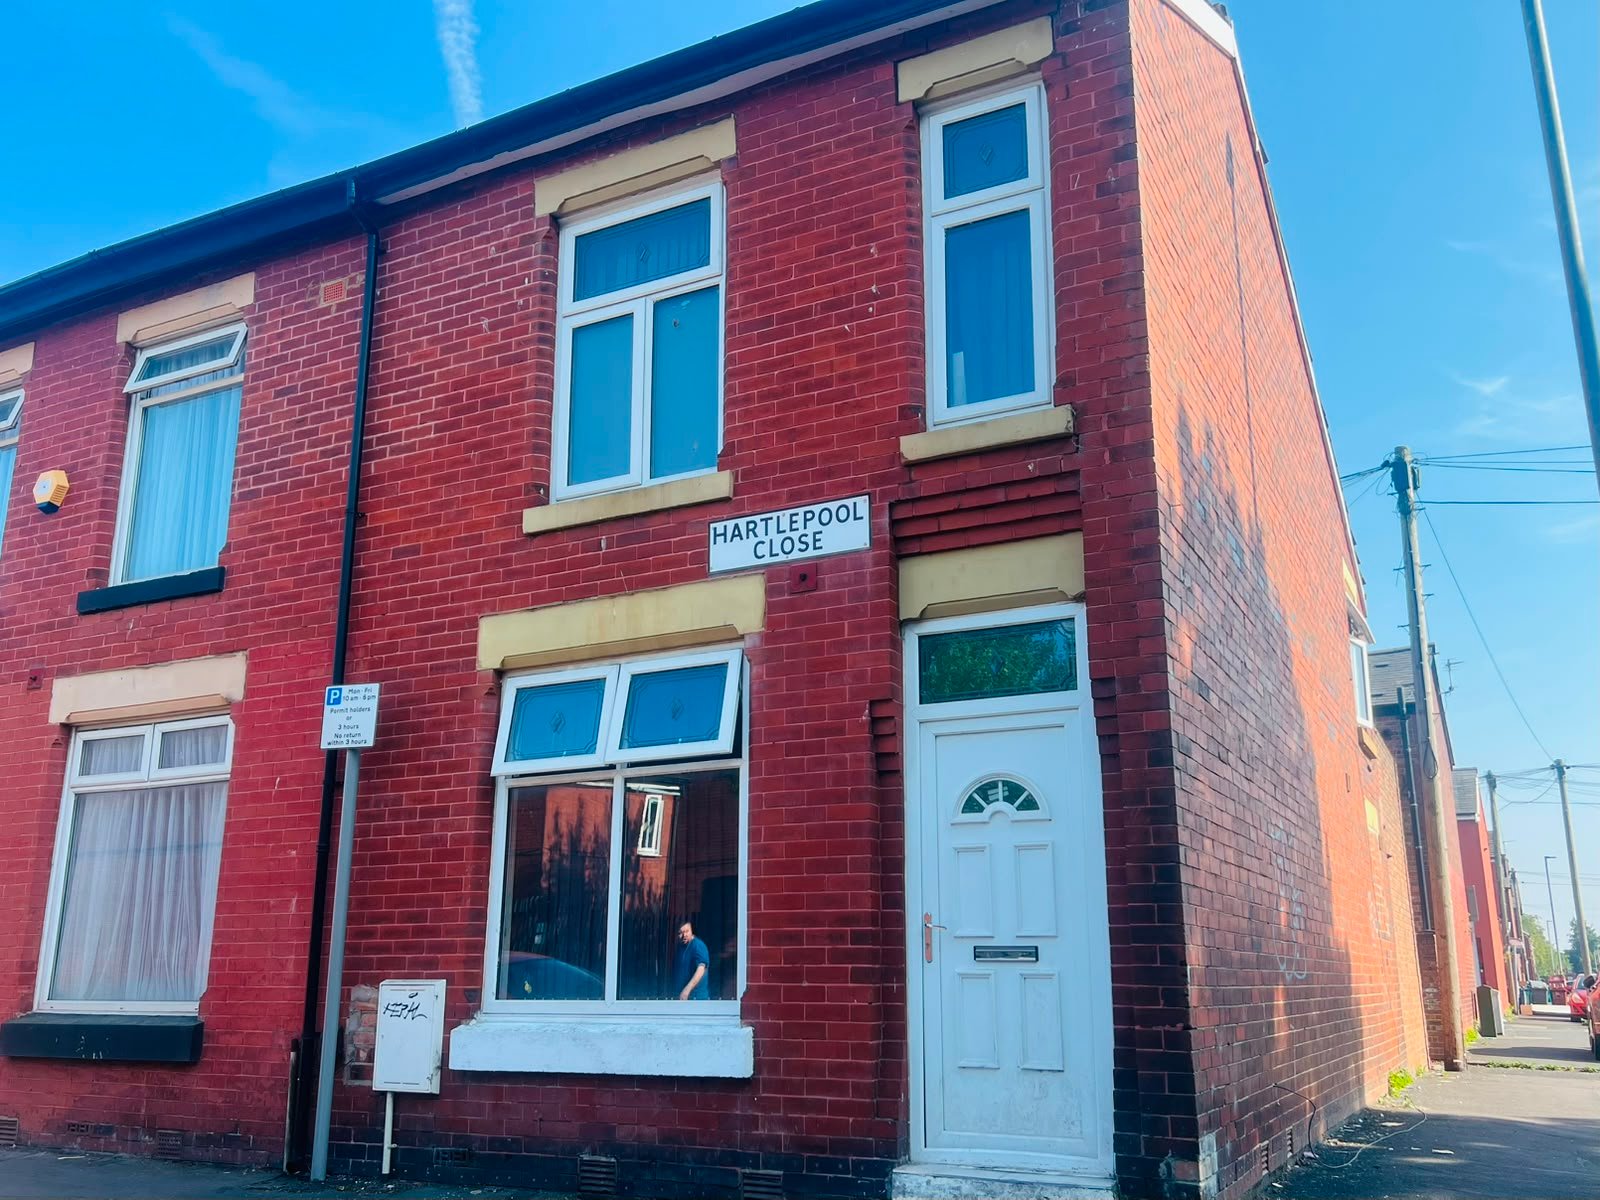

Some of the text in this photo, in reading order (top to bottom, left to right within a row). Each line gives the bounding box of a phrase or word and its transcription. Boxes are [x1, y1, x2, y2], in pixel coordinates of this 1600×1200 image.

[713, 502, 864, 545] HARTLEPOOL
[753, 530, 823, 560] CLOSE
[330, 689, 340, 704] P
